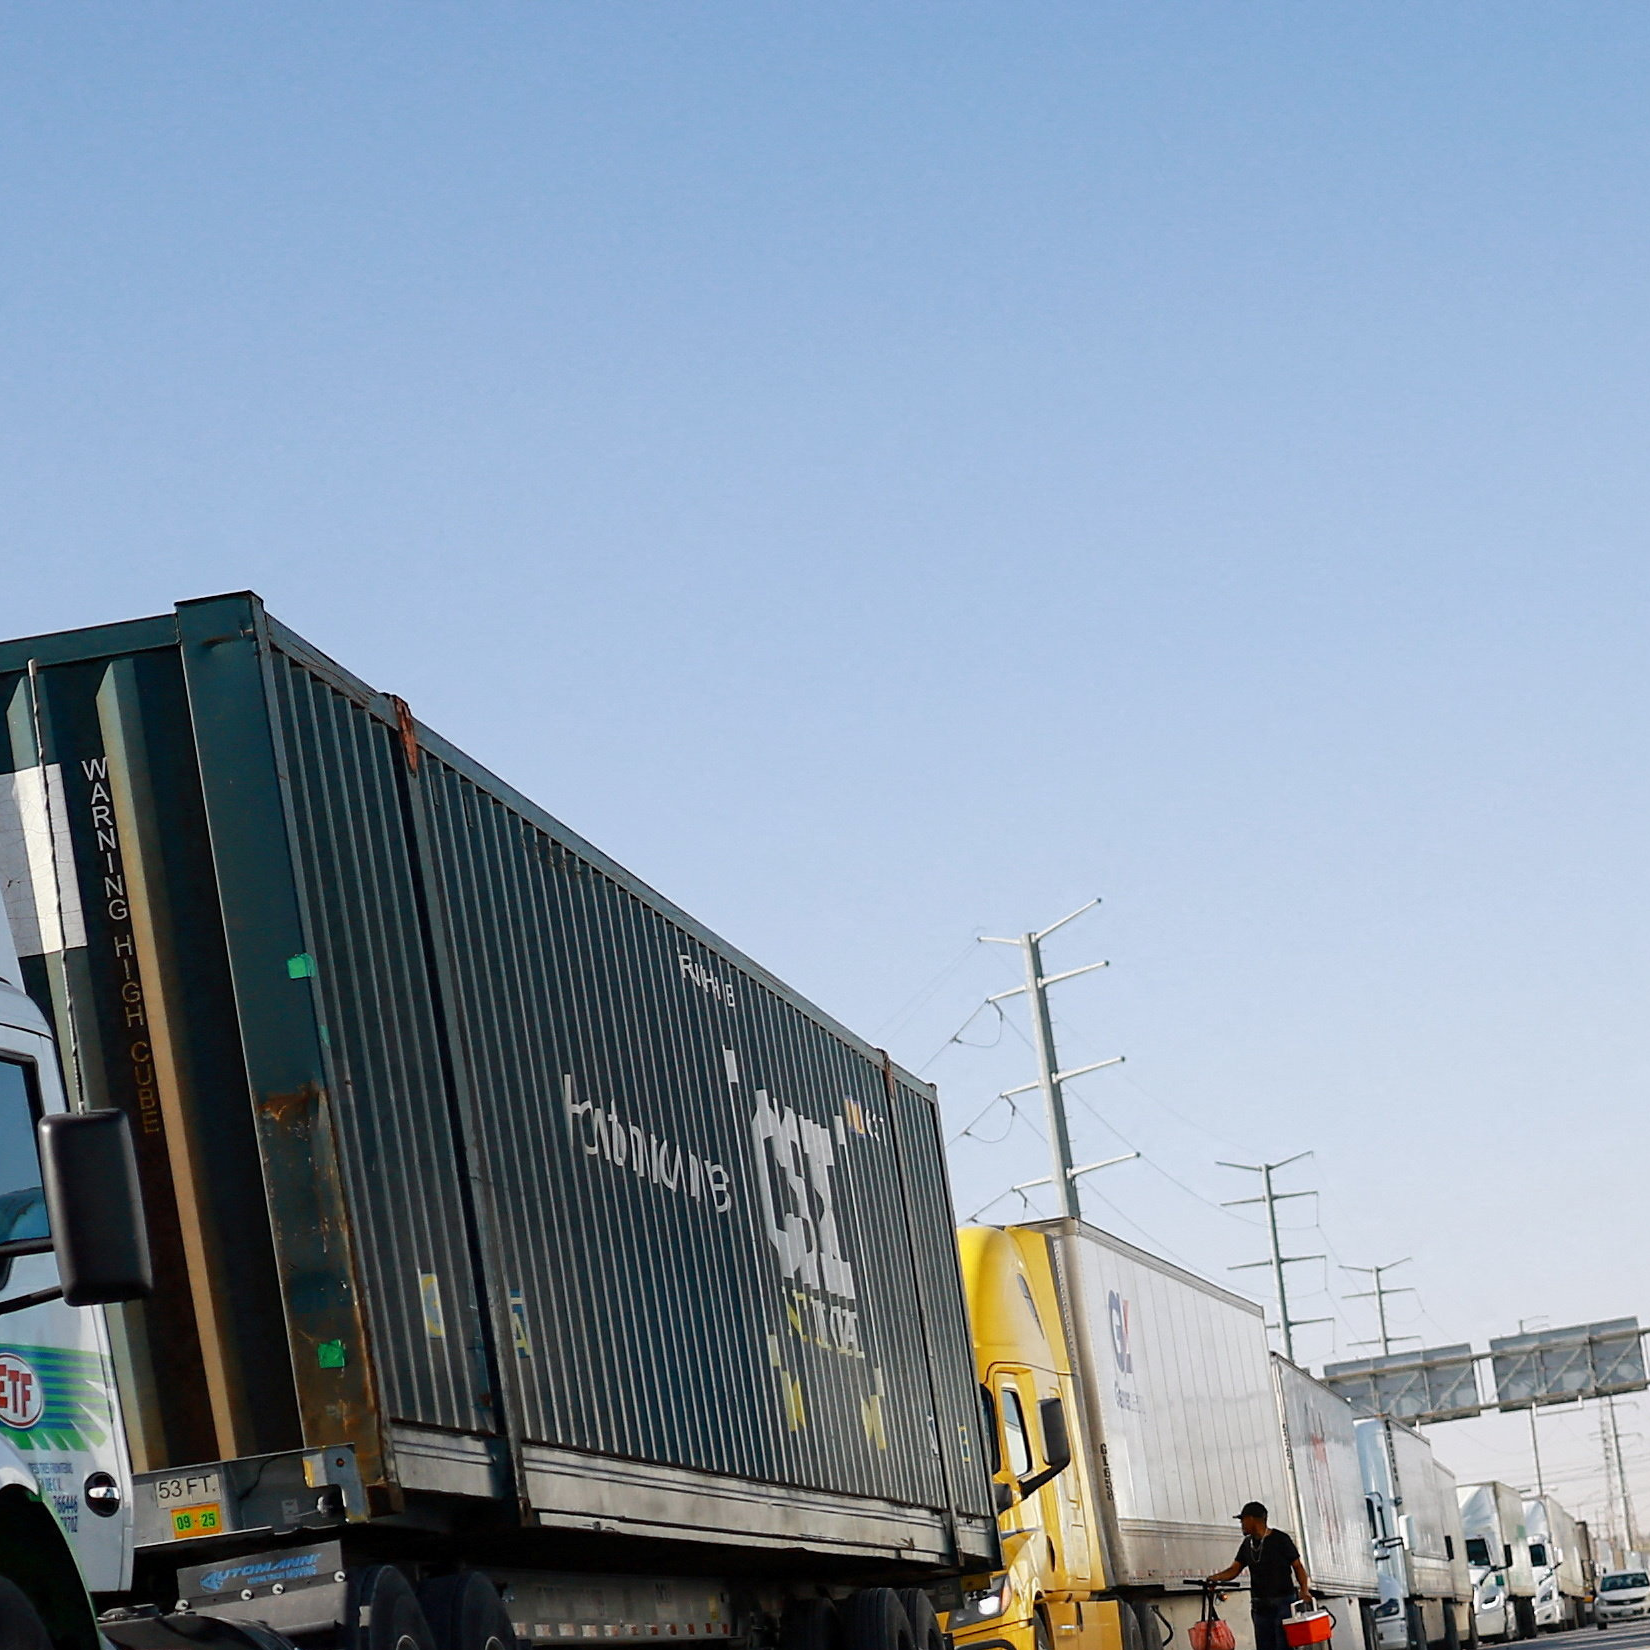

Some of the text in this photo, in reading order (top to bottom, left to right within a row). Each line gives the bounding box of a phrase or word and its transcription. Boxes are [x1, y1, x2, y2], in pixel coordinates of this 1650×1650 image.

[81, 756, 160, 1135] WARNING HIGH CUBE
[158, 1475, 217, 1499] 53 FT.
[176, 1513, 216, 1530] 09 25
